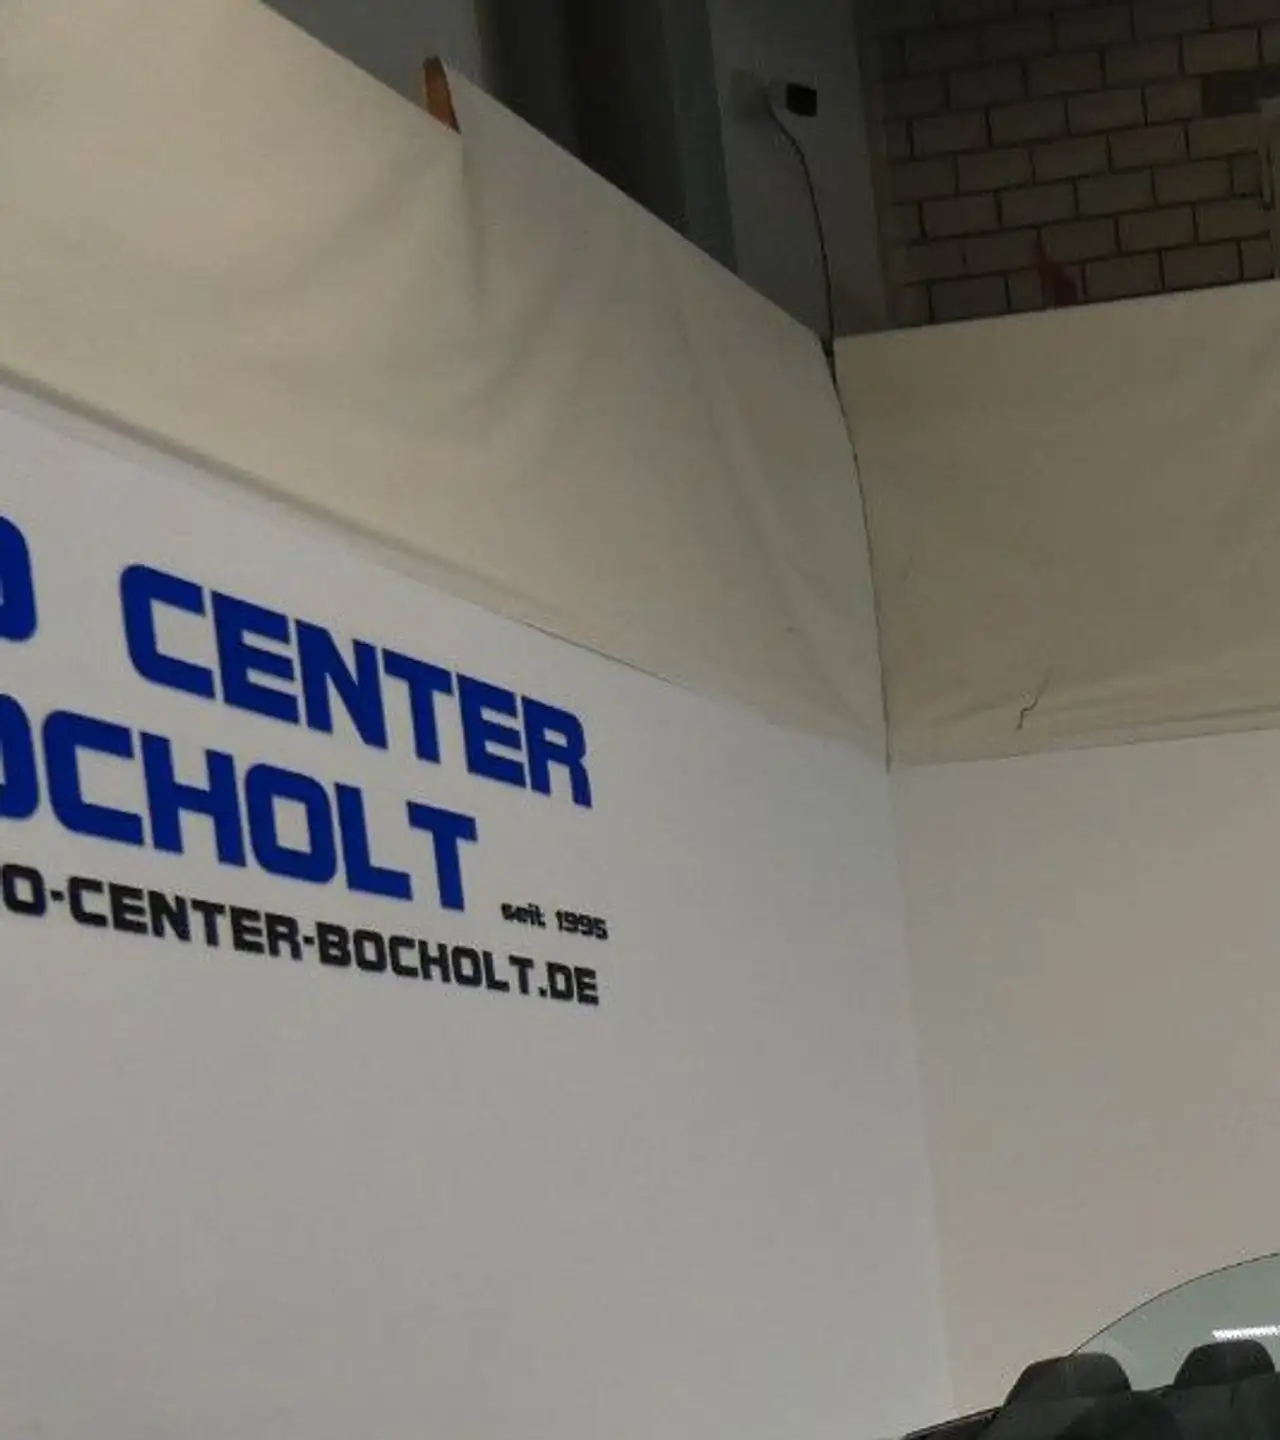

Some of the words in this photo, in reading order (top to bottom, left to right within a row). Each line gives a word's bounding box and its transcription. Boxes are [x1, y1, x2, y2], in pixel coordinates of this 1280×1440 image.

[120, 564, 592, 808] CENTER
[500, 902, 548, 930] seit
[554, 908, 610, 942] 1995
